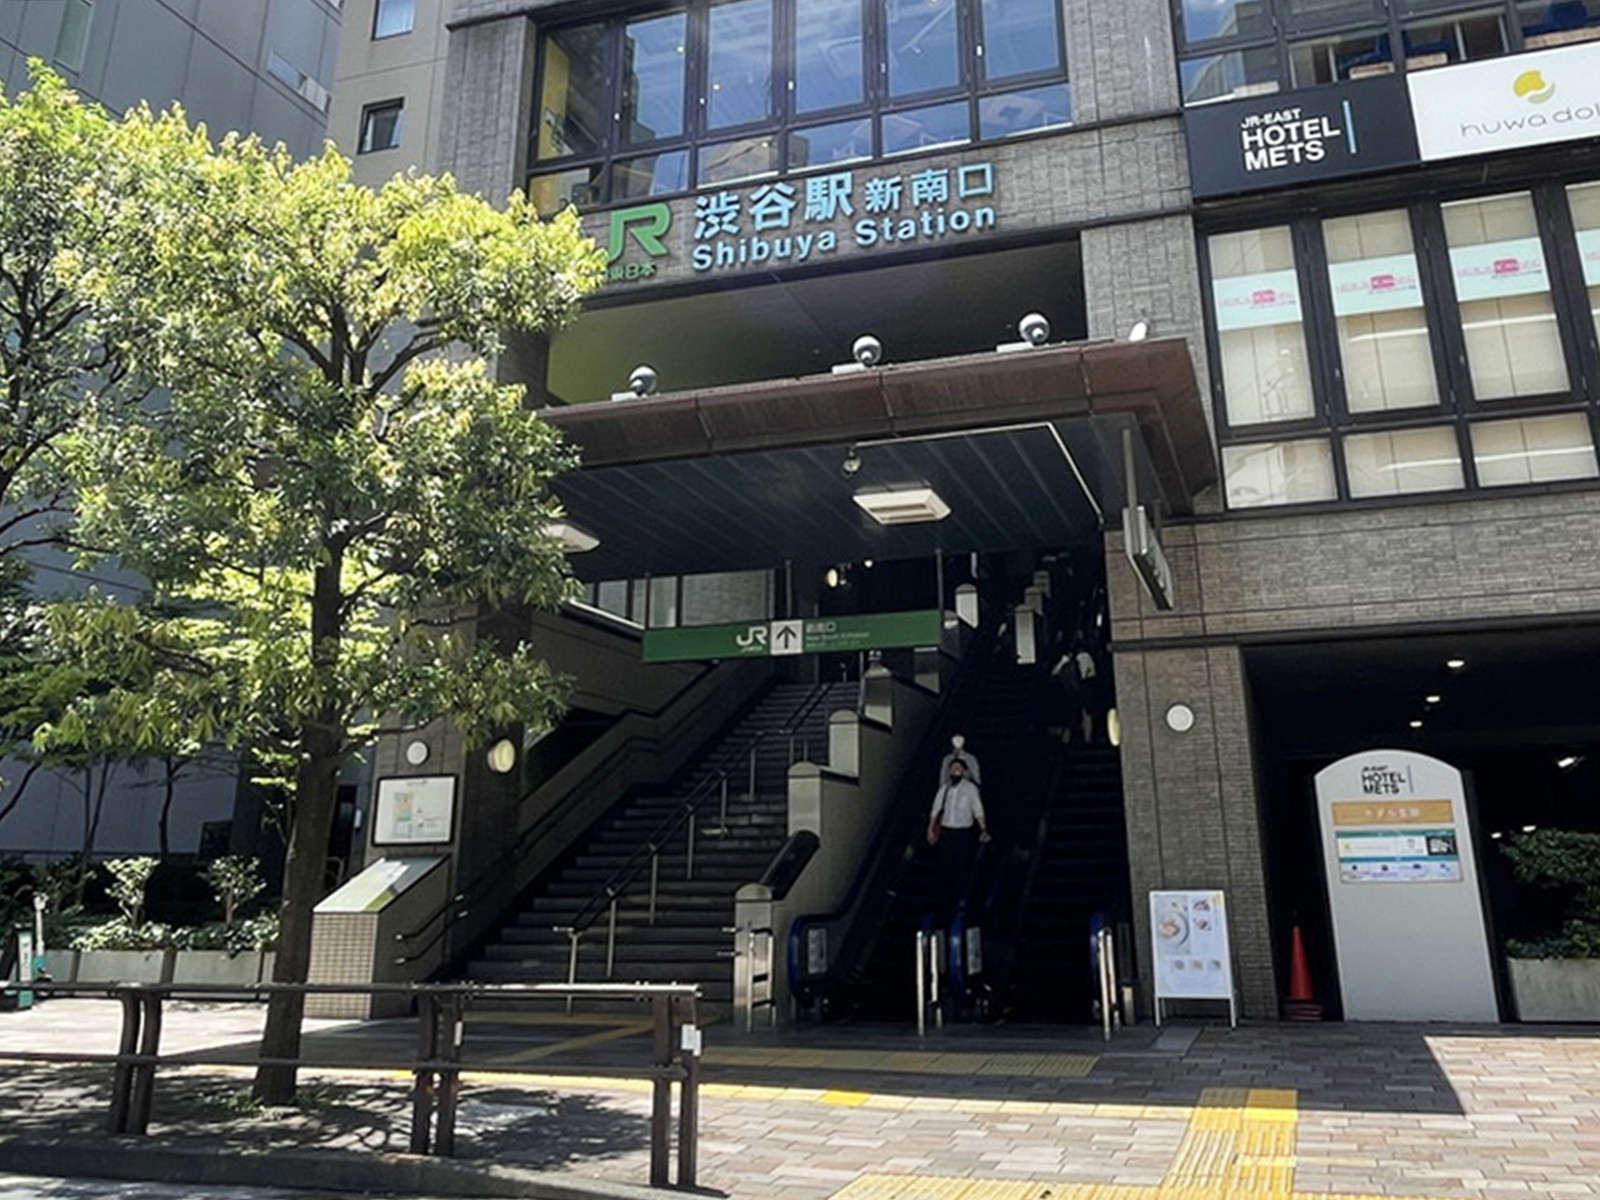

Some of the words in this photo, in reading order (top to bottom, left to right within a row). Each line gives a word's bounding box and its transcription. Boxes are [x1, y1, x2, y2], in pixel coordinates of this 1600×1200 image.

[1240, 107, 1301, 129] JR-EAST
[1241, 116, 1341, 150] HOTEL
[1244, 140, 1325, 171] METS
[693, 171, 855, 240] 渋谷駅
[864, 162, 994, 214] 新南口
[606, 202, 671, 263] JR
[692, 229, 837, 270] Shibuya
[854, 206, 996, 246] Station
[736, 625, 768, 647] JR
[1361, 771, 1406, 784] HOTEL
[1363, 782, 1401, 796] METS
